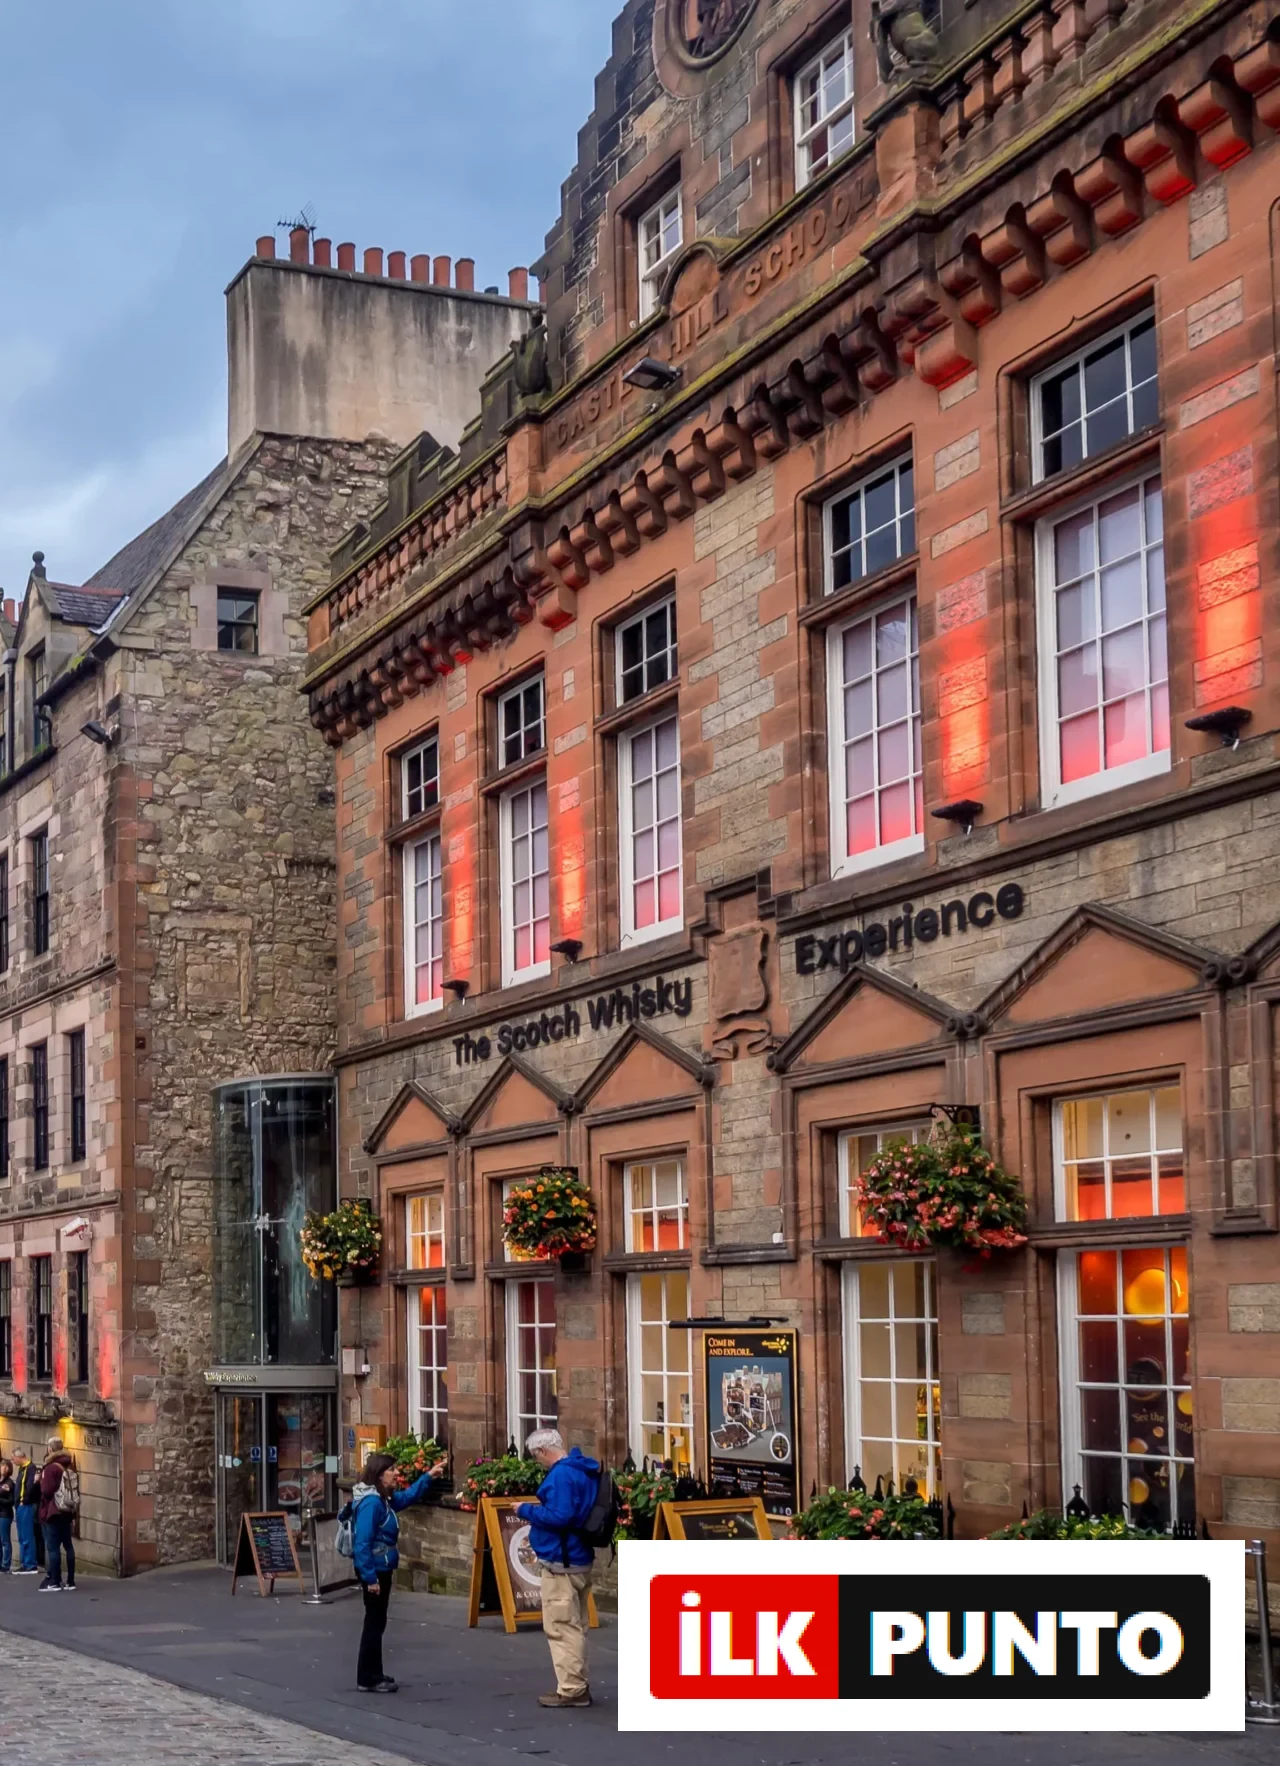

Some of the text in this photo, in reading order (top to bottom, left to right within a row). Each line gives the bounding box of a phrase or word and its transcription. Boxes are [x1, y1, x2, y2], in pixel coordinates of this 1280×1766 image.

[557, 175, 875, 448] CASTL HILL SCHOOL
[453, 881, 1025, 1066] The Scotch Whisky Experience
